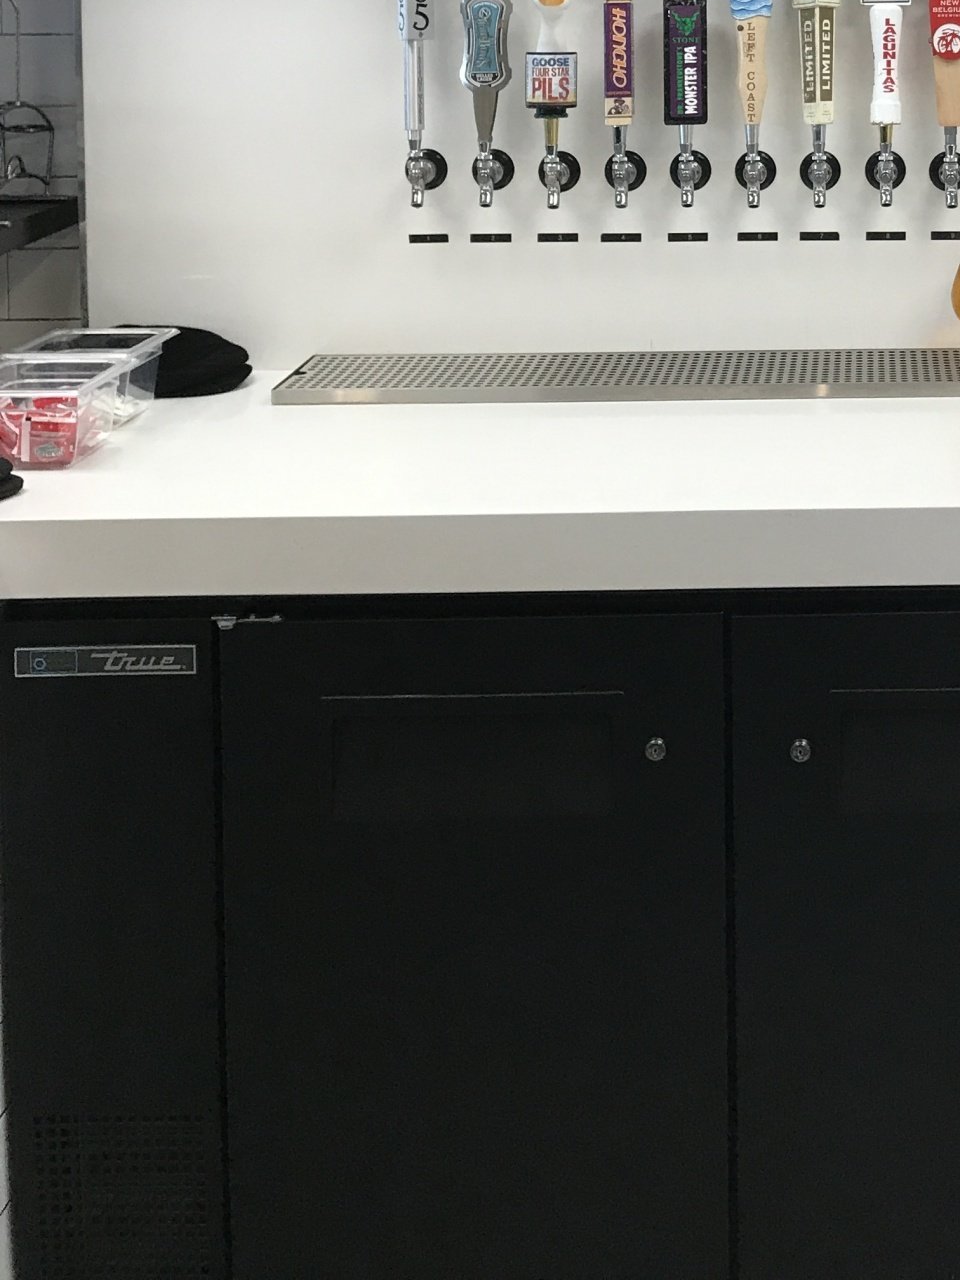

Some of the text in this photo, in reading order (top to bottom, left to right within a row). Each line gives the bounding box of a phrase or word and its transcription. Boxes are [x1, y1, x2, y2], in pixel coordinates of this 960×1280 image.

[532, 57, 570, 67] GOOSE
[612, 7, 627, 88] HONCHO
[747, 22, 755, 63] LEFT
[804, 20, 814, 92] LIMITED
[822, 19, 830, 90] LIMITED
[883, 18, 897, 93] LAGUNITAS
[532, 78, 570, 100] PILS
[684, 46, 698, 114] MONSTER IPA
[747, 71, 755, 122] COAST
